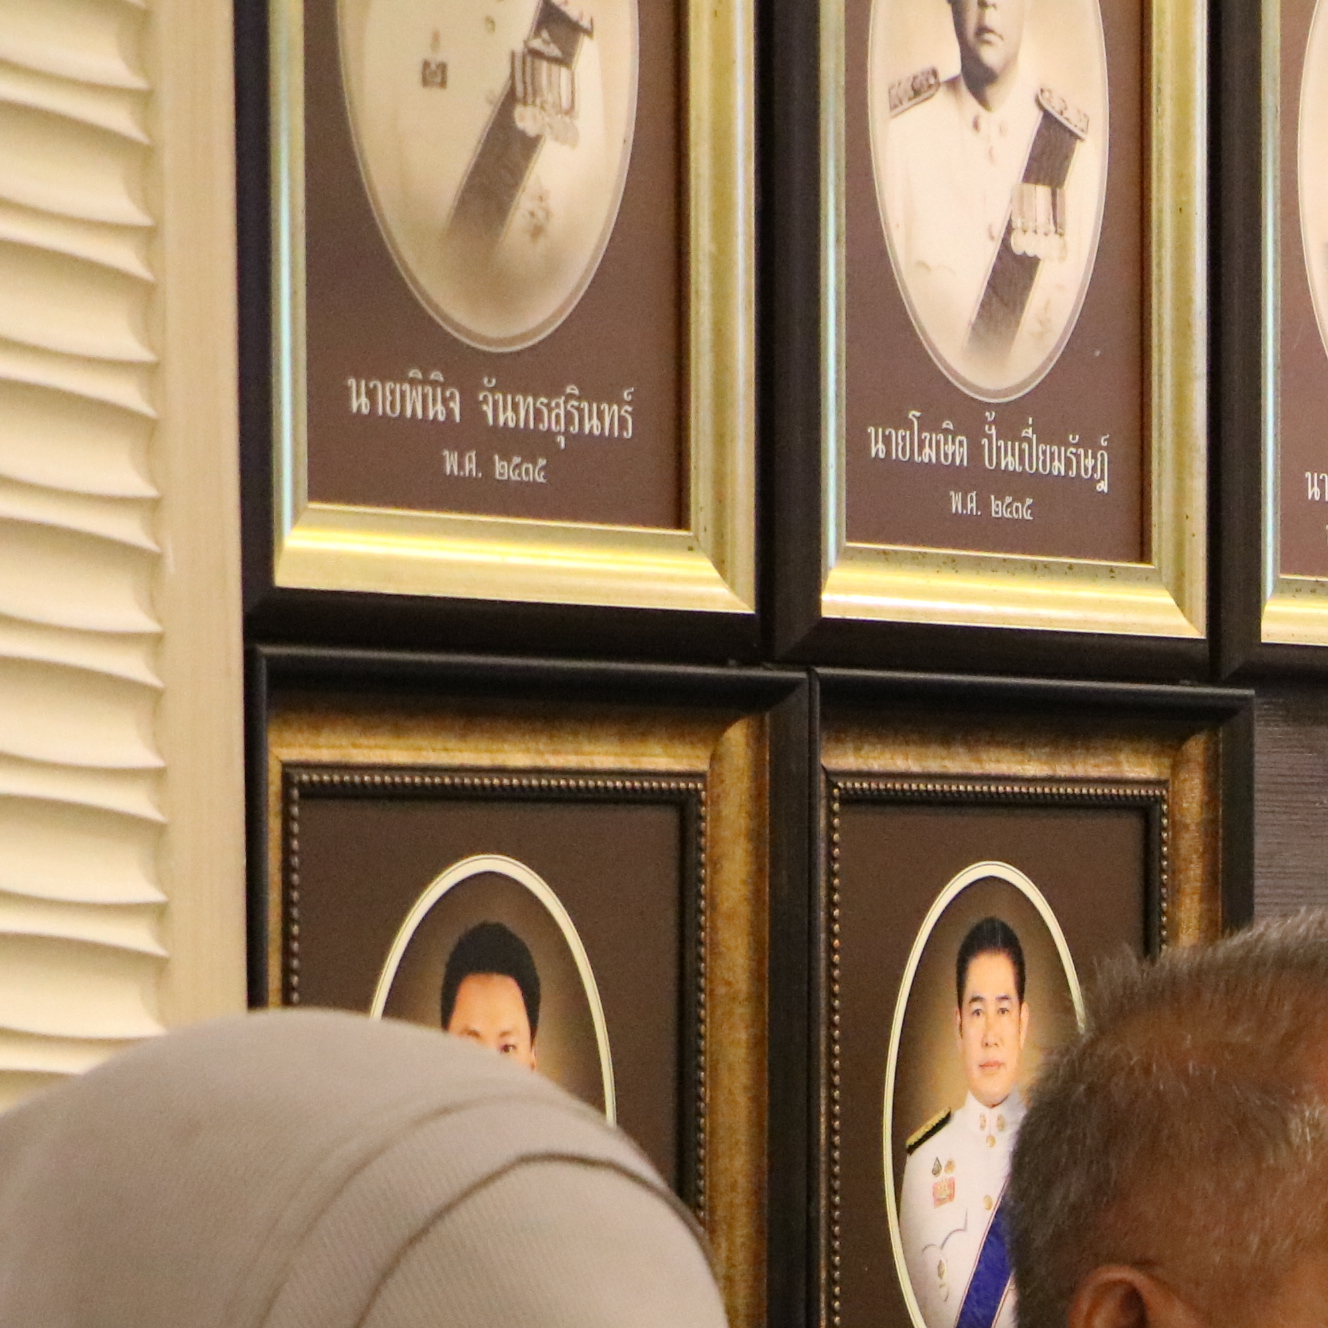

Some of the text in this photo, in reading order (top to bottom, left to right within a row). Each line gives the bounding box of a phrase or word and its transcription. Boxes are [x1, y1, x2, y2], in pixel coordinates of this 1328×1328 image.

[348, 369, 634, 449] นายพินิจ จันทรสุรินทร์
[443, 450, 547, 483] พ.ศ. ๒๕๓๕
[868, 410, 1110, 493] นายโฆษิต ปั้นเปี่ยมรัษฎ์
[950, 490, 1033, 520] พ.ศ. ๒๕๓๕
